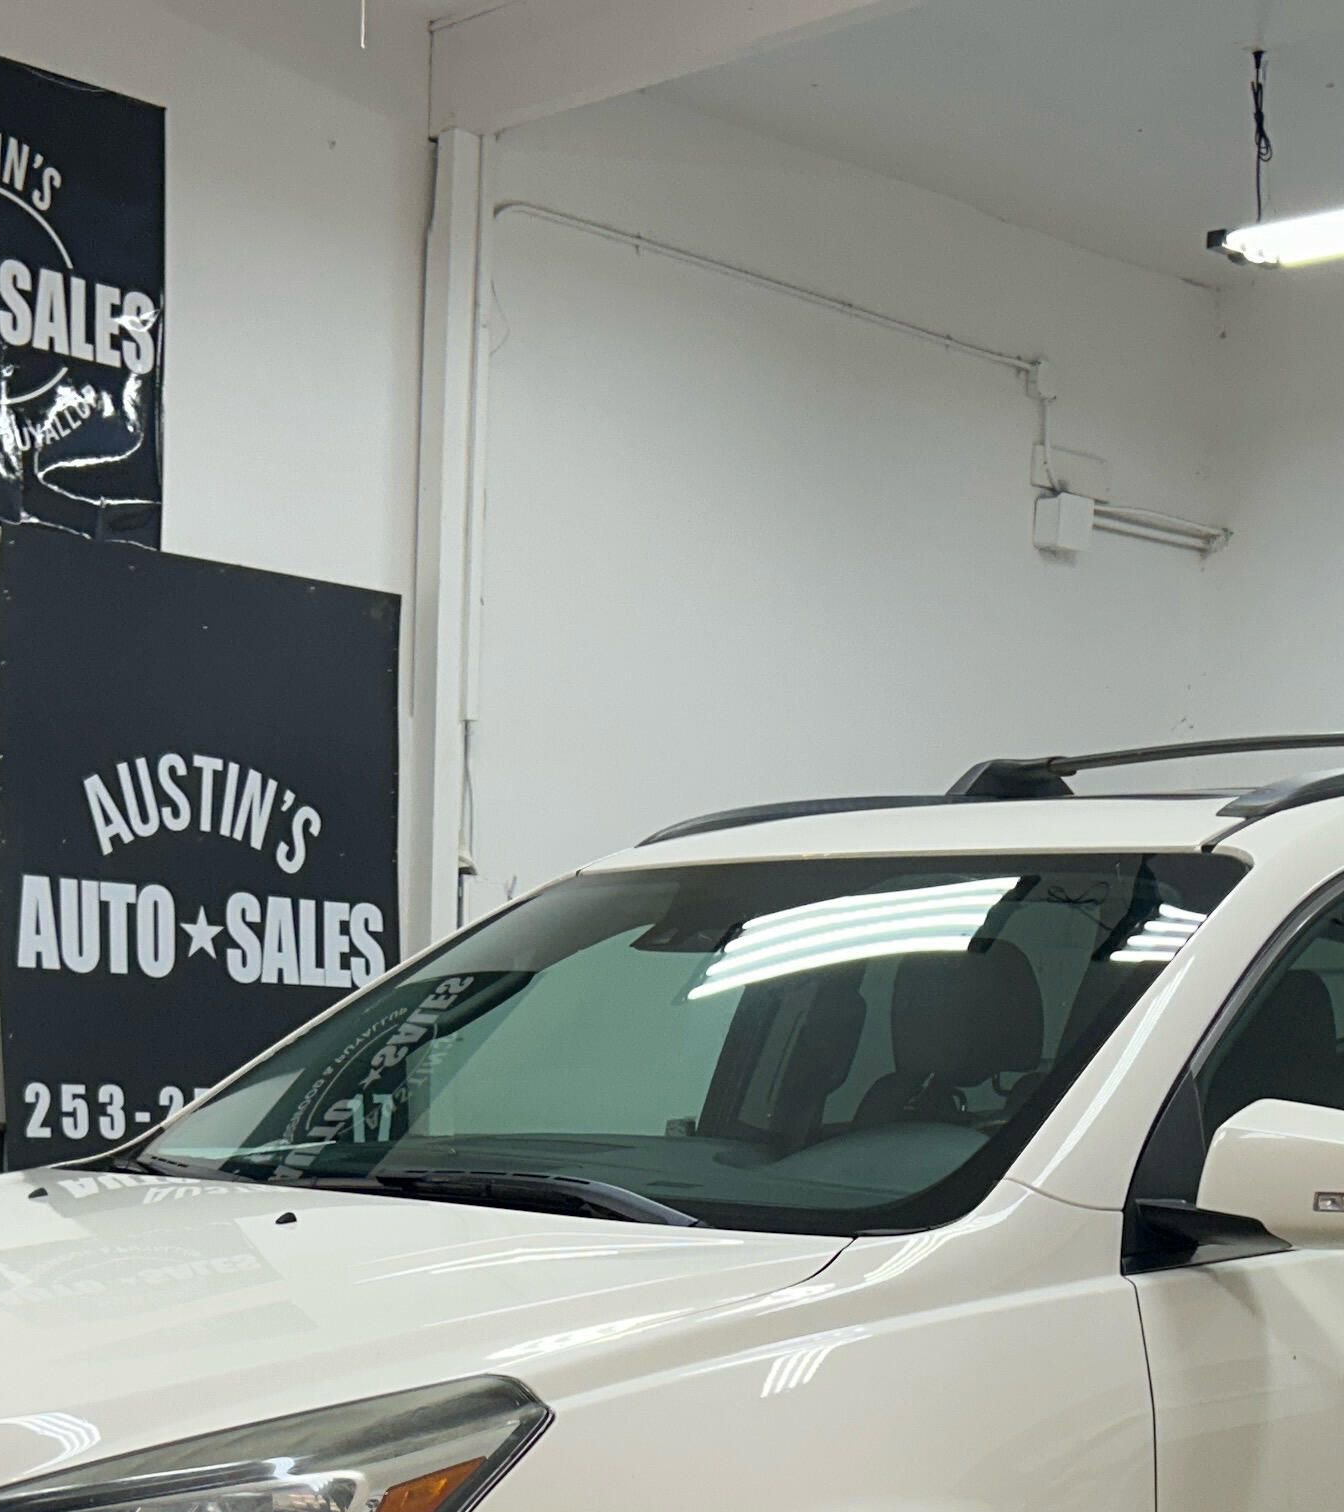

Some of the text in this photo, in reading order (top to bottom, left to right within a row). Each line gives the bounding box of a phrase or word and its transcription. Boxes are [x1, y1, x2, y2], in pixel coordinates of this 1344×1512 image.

[83, 753, 323, 874] AUSTIN'S
[17, 874, 386, 989] AUTO SALES
[24, 1082, 212, 1140] 253-2
